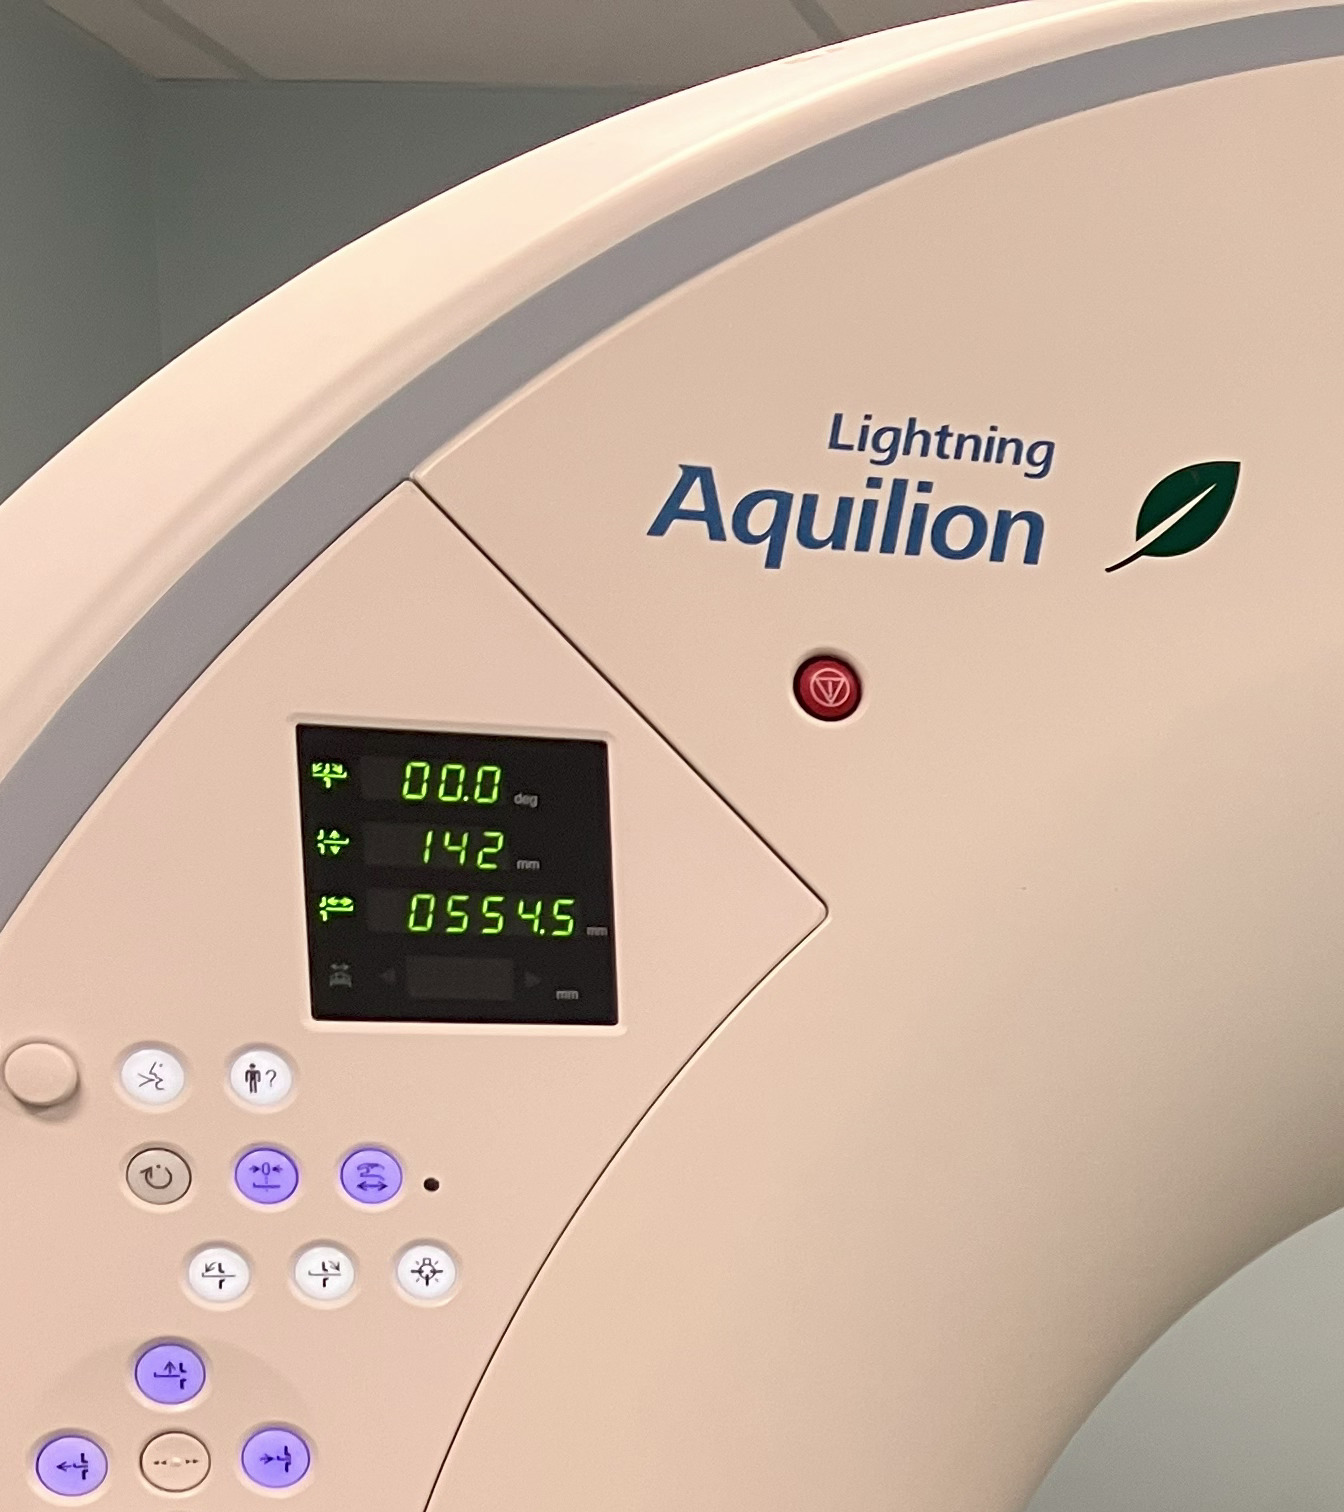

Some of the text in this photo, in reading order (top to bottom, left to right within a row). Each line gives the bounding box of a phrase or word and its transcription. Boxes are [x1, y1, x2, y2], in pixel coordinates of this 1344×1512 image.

[827, 412, 1055, 479] Lightning
[646, 463, 1046, 570] Aquilion
[402, 761, 501, 804] 00.0
[422, 829, 504, 870] 142
[408, 893, 576, 936] 0554.5
